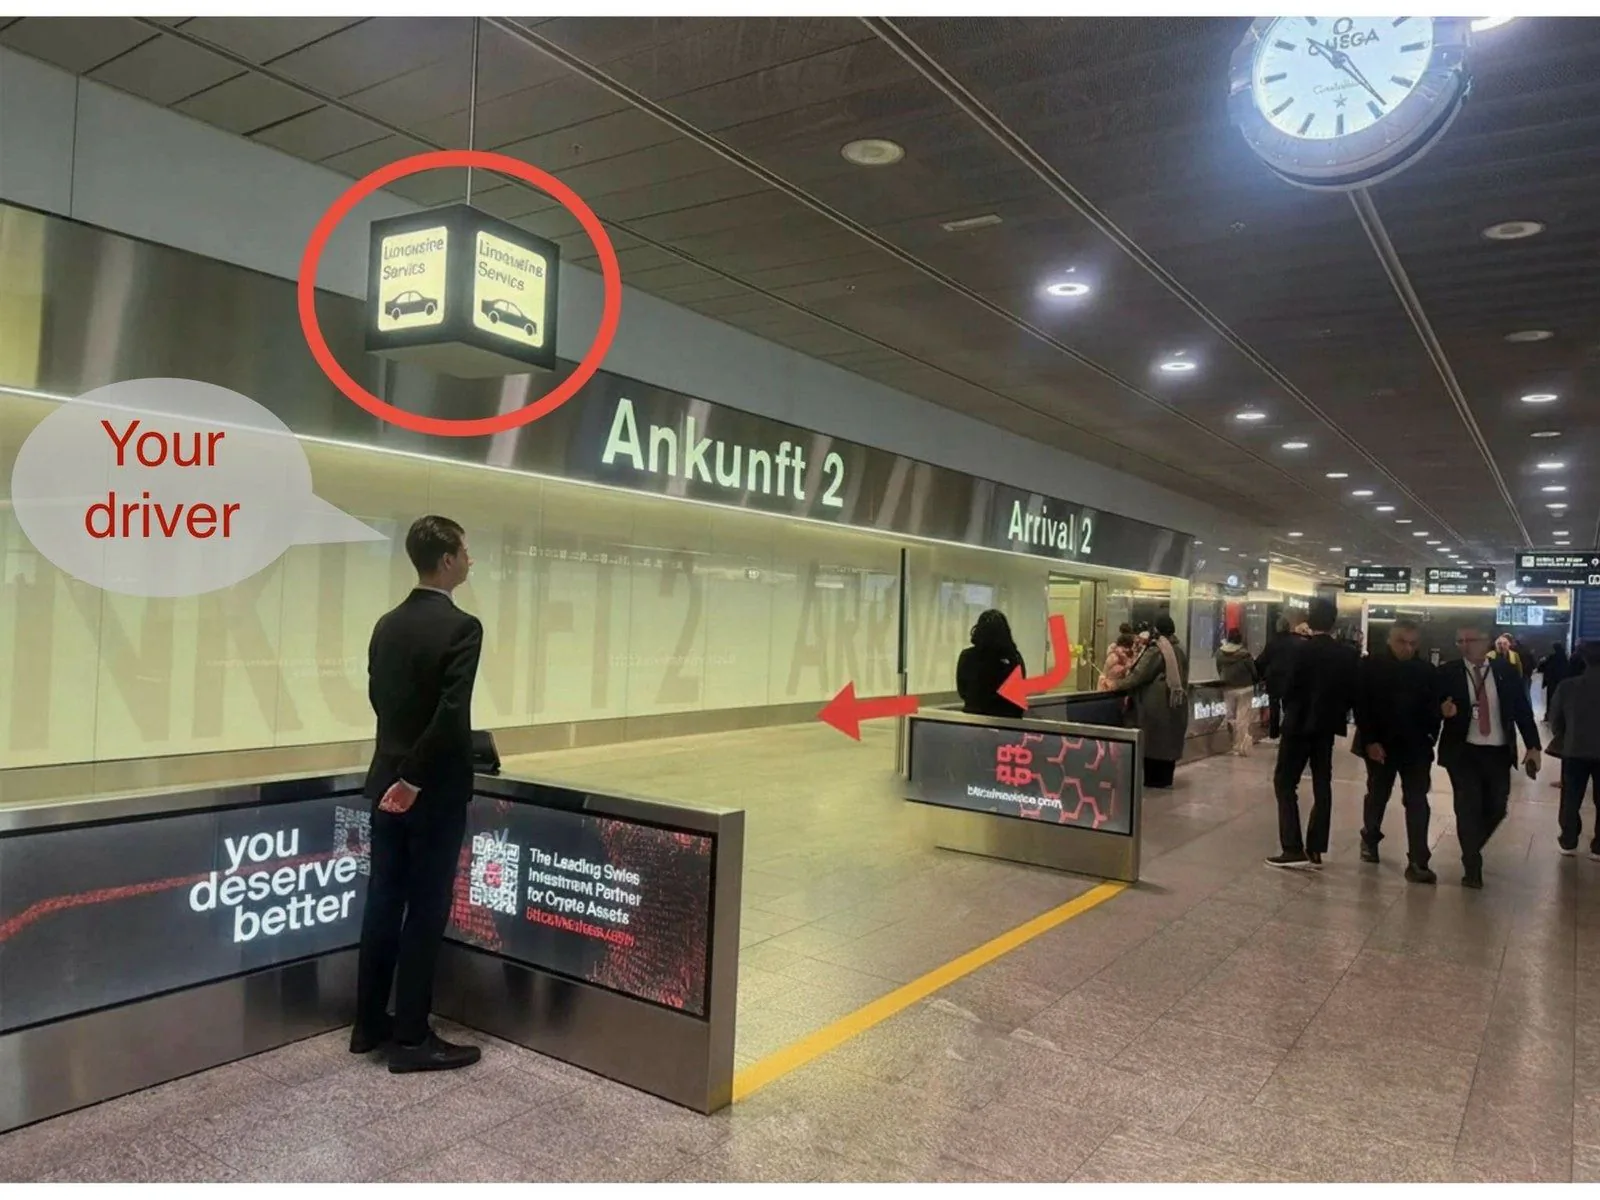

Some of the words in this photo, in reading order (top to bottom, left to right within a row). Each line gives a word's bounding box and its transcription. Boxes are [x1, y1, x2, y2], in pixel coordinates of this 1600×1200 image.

[601, 397, 806, 501] Ankunft
[821, 451, 845, 507] 2
[1007, 500, 1074, 551] Arrival
[1080, 516, 1093, 554] 2
[224, 828, 300, 875] you
[529, 847, 551, 866] The
[189, 855, 357, 912] deserve
[527, 886, 544, 903] for
[233, 889, 356, 943] better
